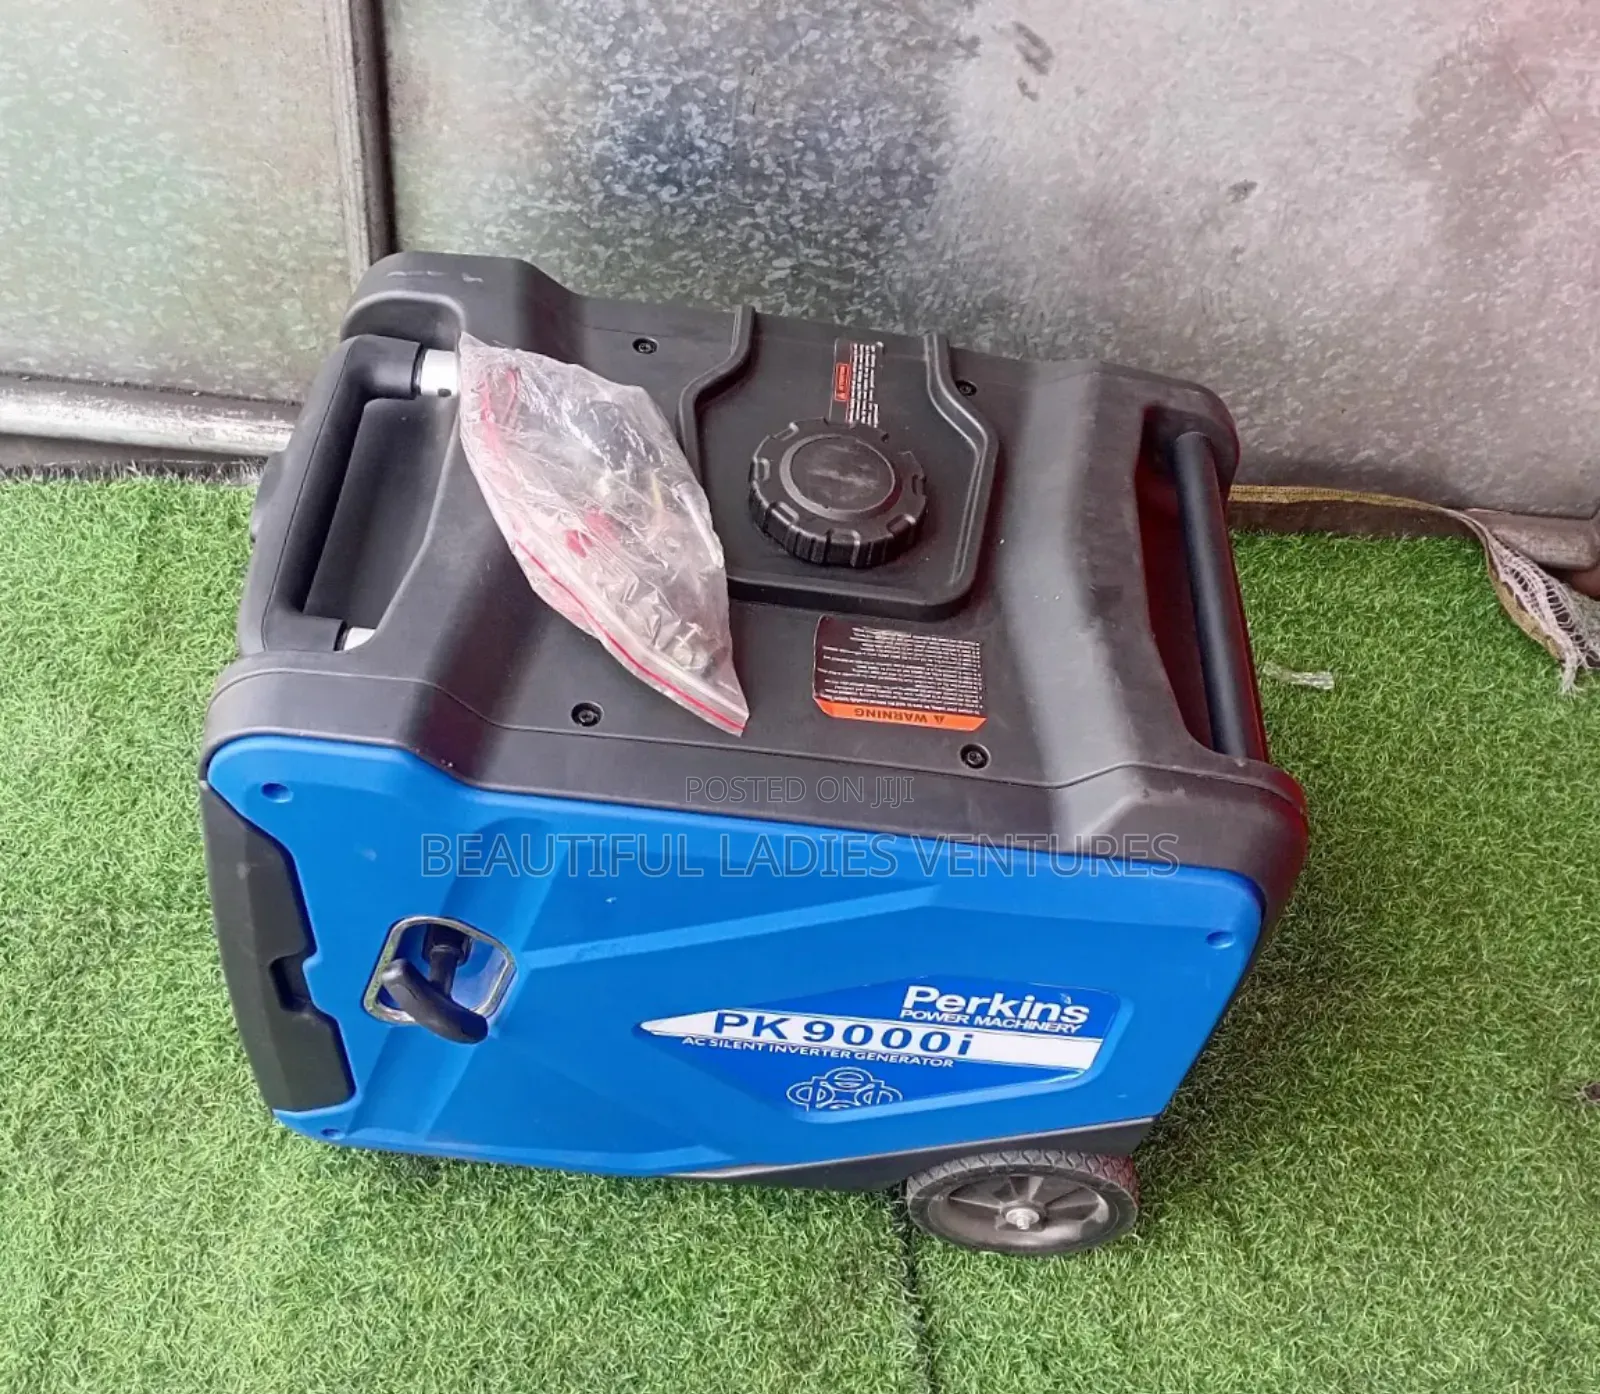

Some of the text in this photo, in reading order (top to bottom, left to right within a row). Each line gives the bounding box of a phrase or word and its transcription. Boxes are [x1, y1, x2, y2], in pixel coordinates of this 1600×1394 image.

[854, 707, 928, 723] WARNING
[903, 985, 1090, 1025] Perkins
[900, 1009, 1083, 1034] POWER MACHINERY
[682, 1036, 954, 1069] AC SILENT INVERTER GENERATOR
